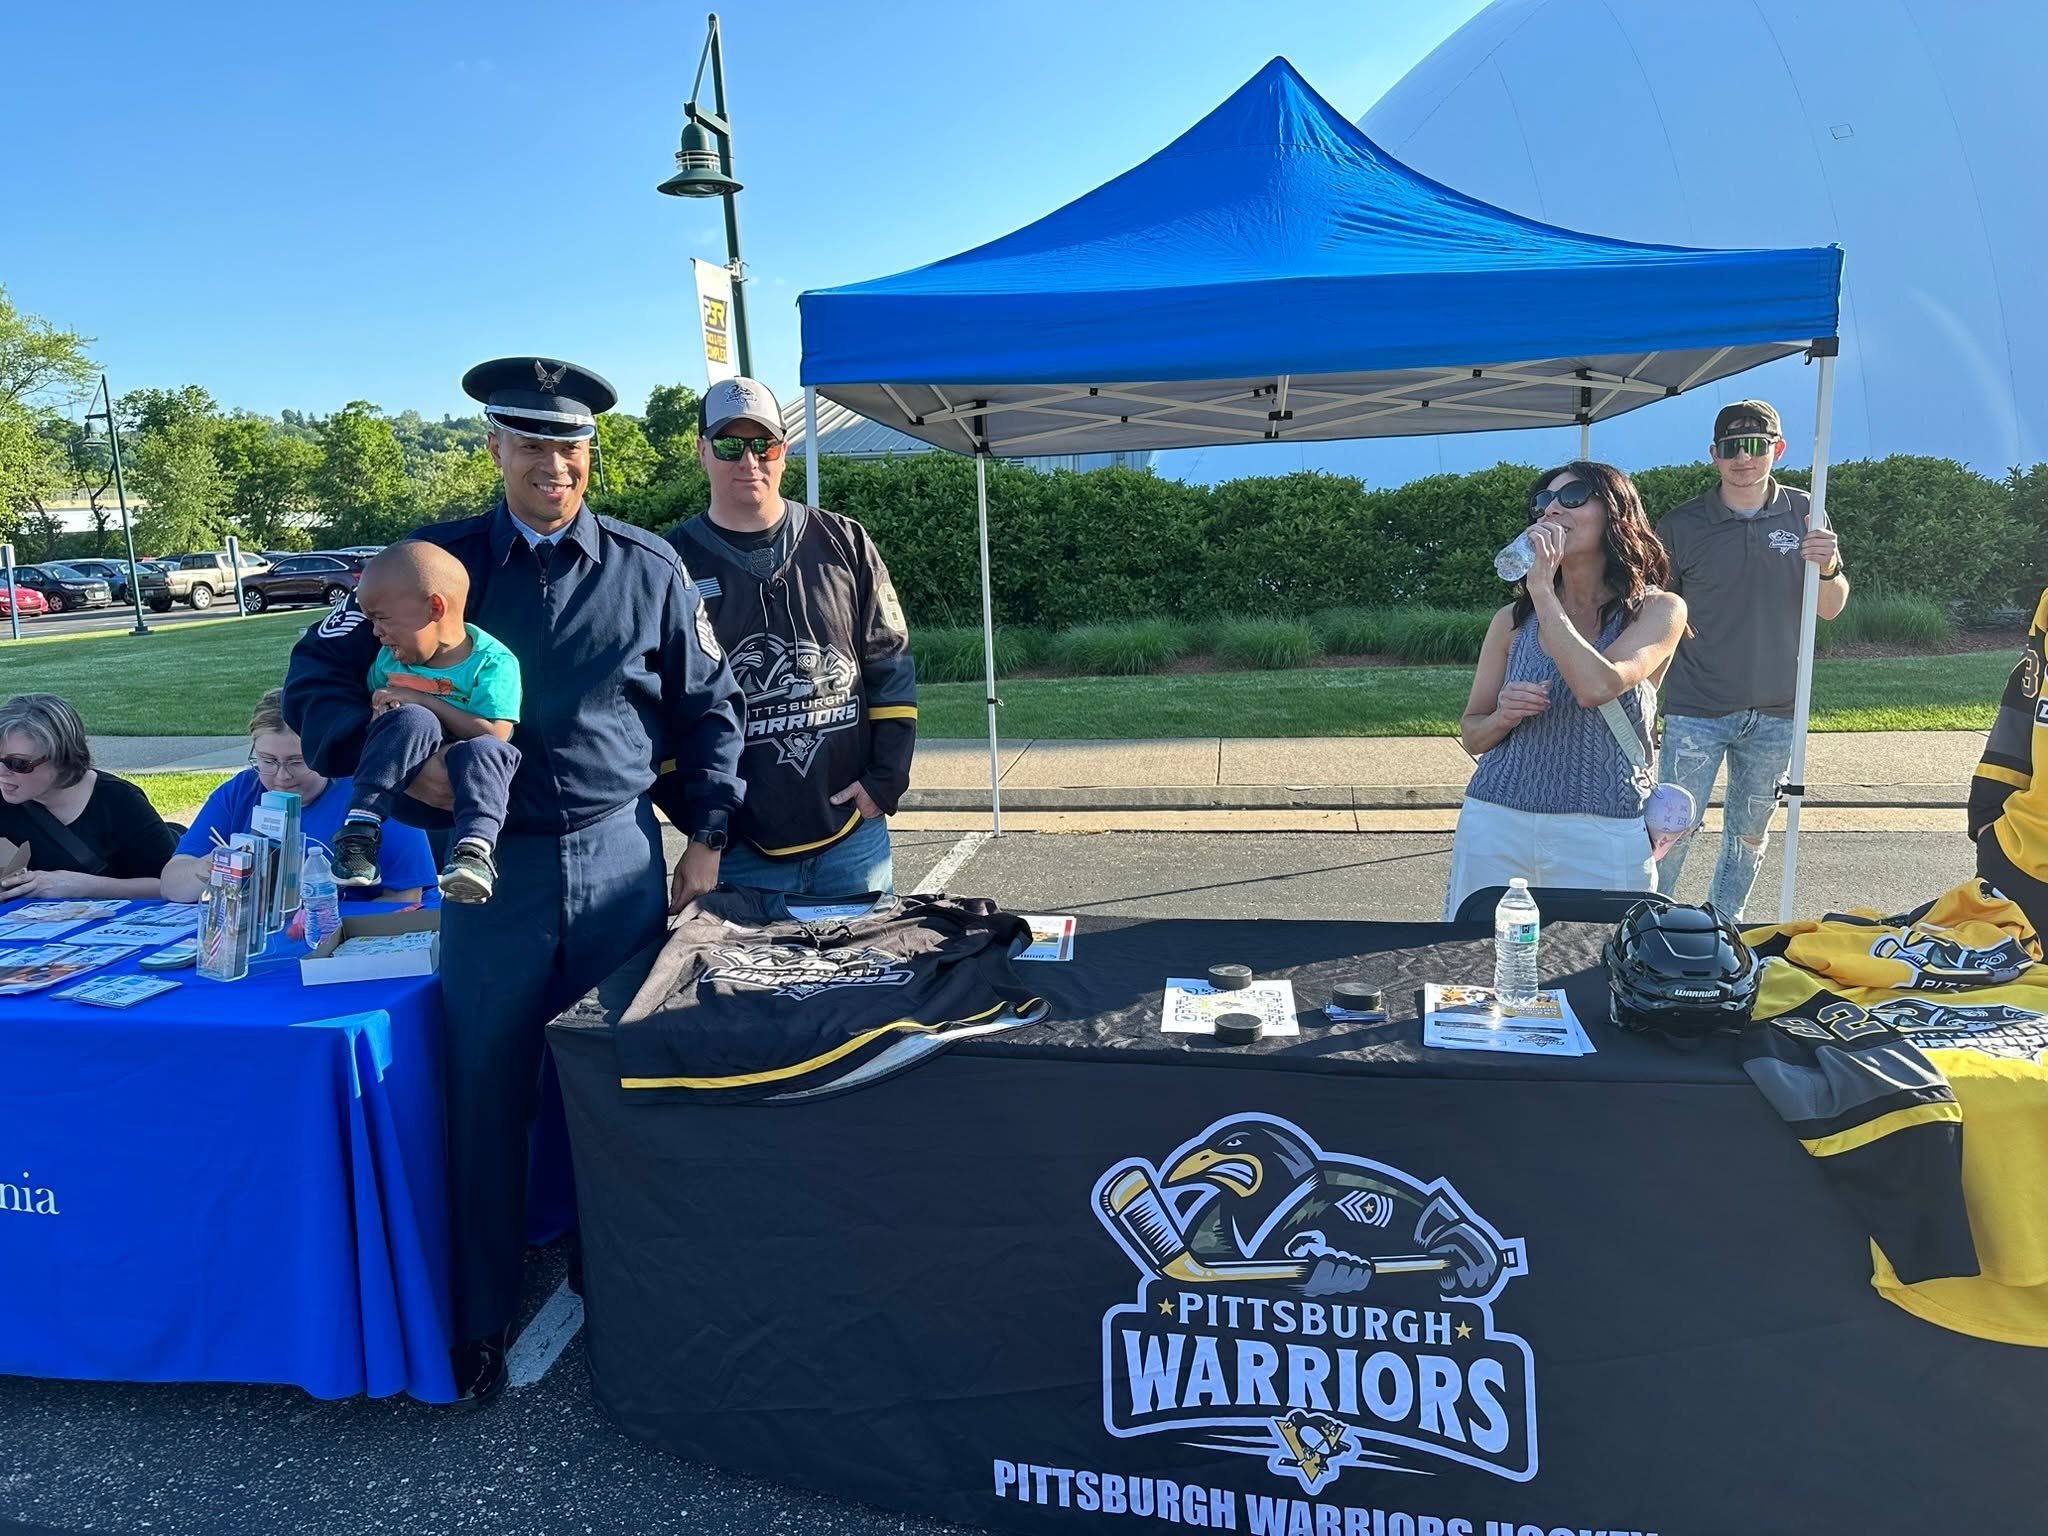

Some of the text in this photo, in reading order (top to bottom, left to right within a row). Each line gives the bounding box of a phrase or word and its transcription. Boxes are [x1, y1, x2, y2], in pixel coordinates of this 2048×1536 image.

[746, 693, 847, 719] ITTSBURGH
[746, 702, 858, 738] ARRIORS
[1674, 989, 1721, 998] WARRIOR
[1177, 1291, 1452, 1346] PITTSBURGH
[1122, 1329, 1510, 1454] WARRIORS
[993, 1458, 1237, 1531] PITTSBURGH
